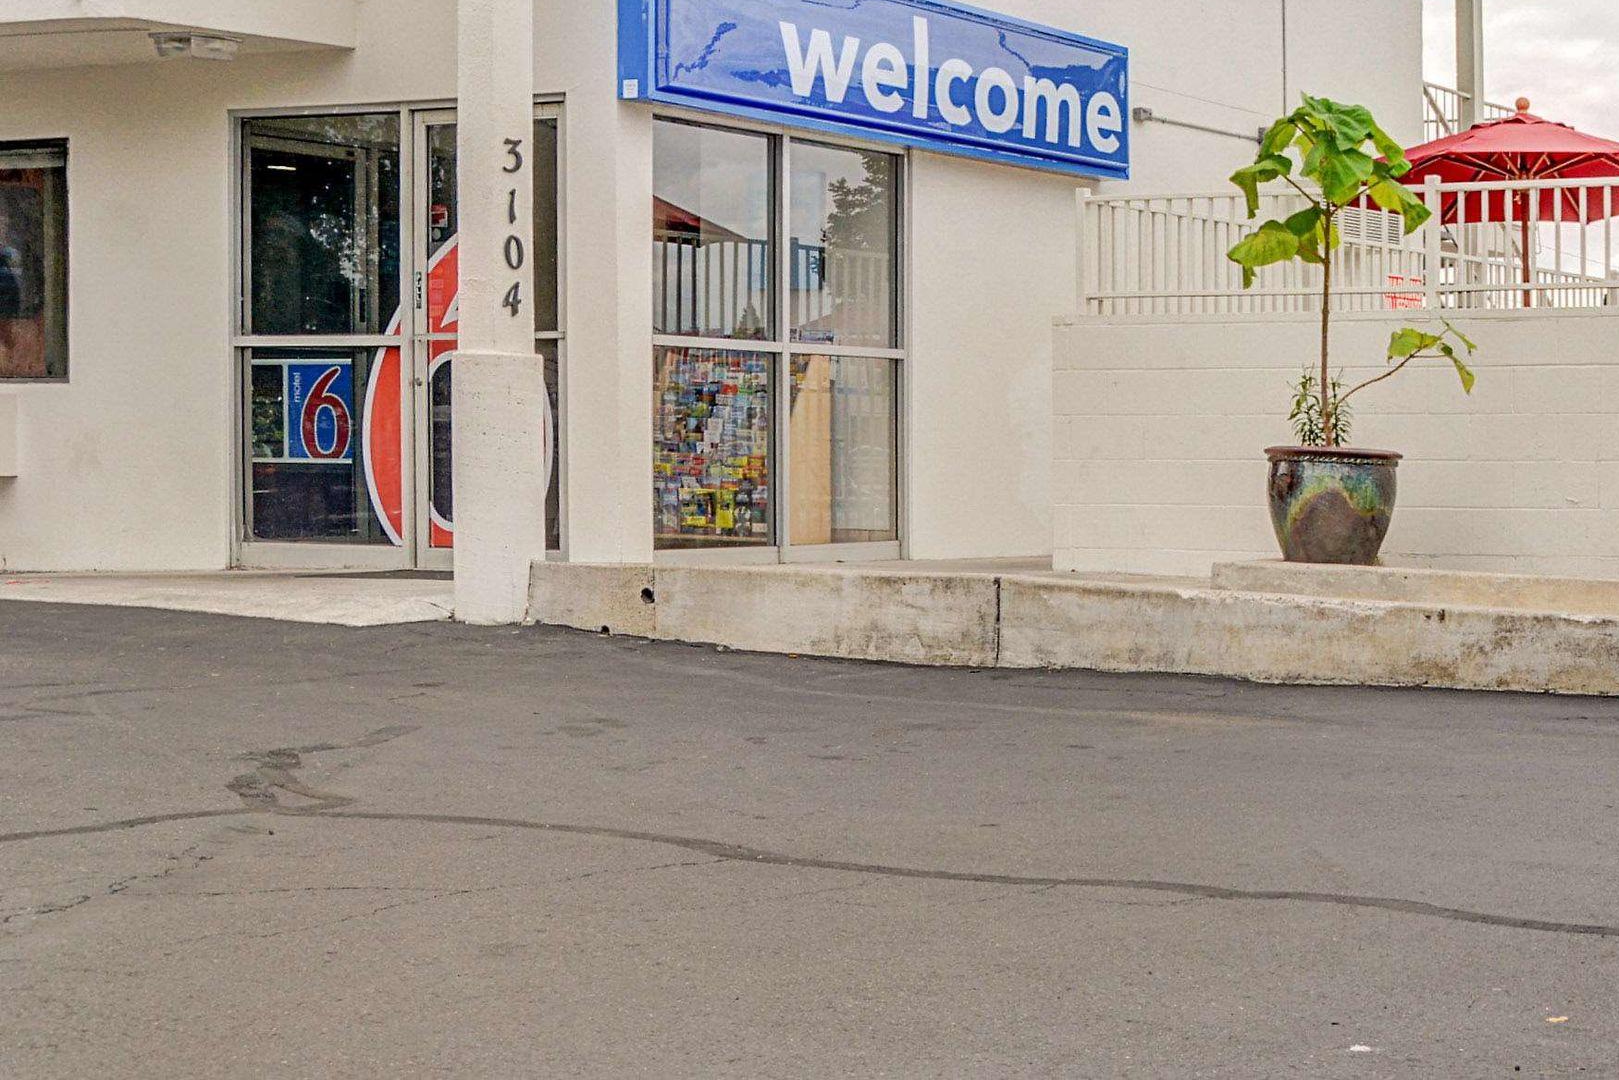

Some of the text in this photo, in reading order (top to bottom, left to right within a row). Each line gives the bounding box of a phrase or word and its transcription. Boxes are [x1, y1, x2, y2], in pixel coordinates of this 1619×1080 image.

[778, 16, 1124, 153] welcome
[502, 137, 524, 318] 3104
[293, 365, 351, 459] motel 6
